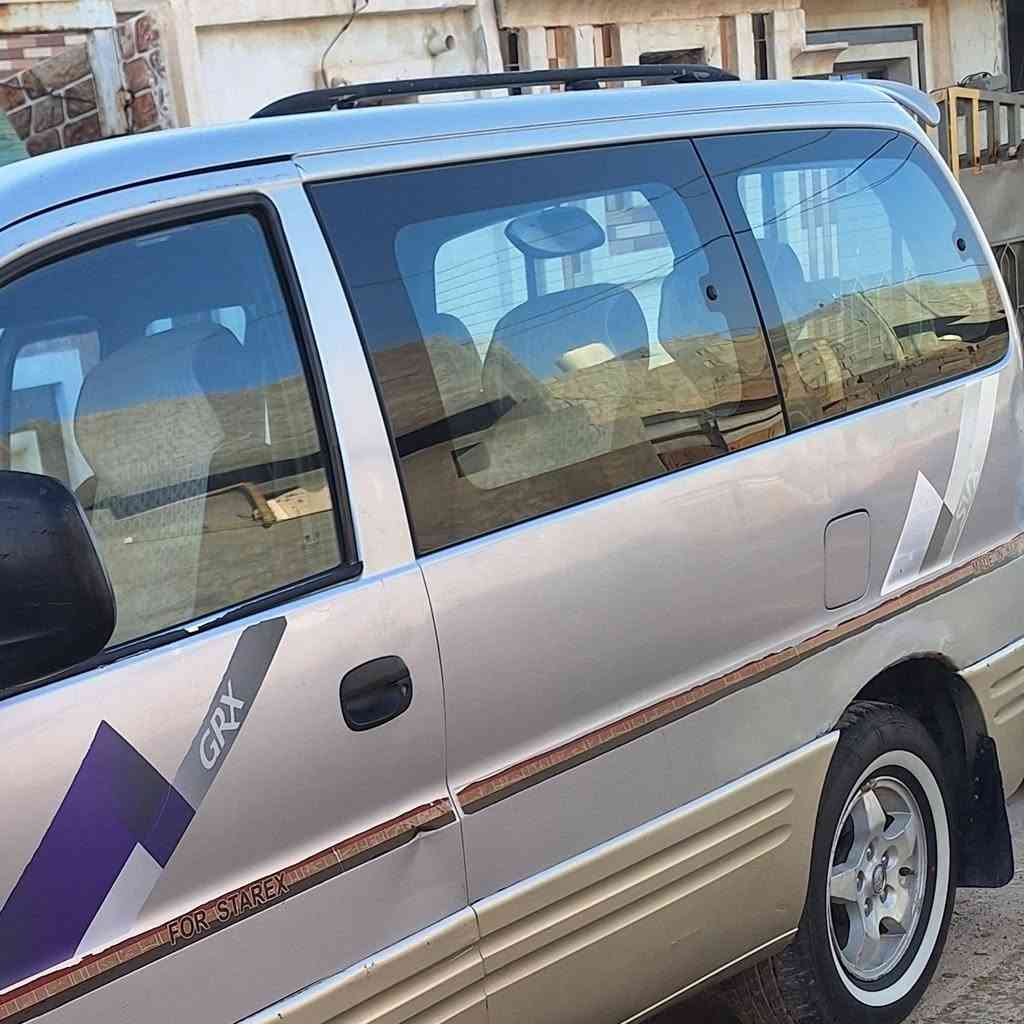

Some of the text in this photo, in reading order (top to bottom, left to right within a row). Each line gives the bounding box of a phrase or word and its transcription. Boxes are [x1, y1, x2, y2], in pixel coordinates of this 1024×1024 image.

[199, 679, 245, 770] GRX
[167, 872, 290, 945] FOR STAREX
